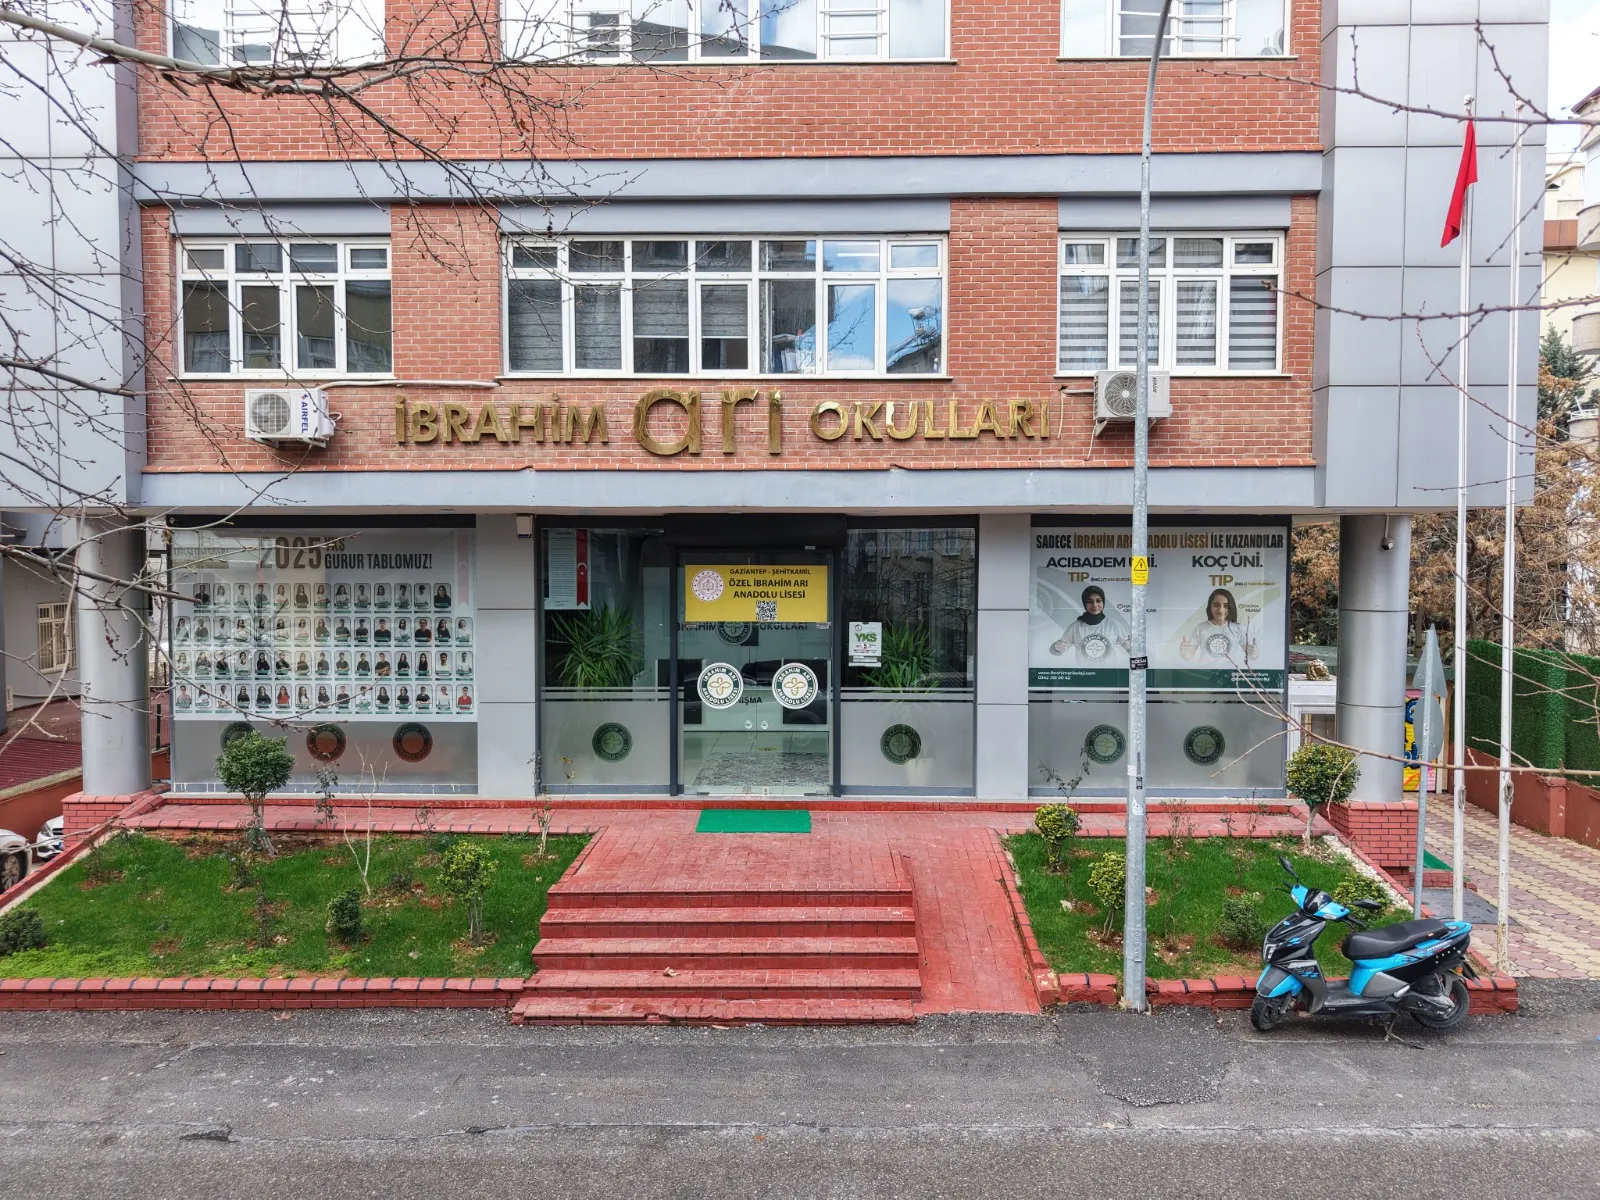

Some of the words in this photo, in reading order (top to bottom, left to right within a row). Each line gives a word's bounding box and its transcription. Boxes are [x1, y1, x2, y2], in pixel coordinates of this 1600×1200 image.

[395, 394, 609, 443] İBRAHİM
[810, 400, 1050, 441] OKULLARI
[1036, 534, 1071, 549] SADECE
[1074, 532, 1114, 549] İBRAHİM
[1180, 532, 1209, 549] LİSESİ
[1211, 532, 1224, 549] İLE
[1226, 534, 1284, 549] KAZANDILAR
[261, 536, 322, 570] 2025
[324, 553, 364, 570] GURUR
[367, 553, 433, 570] TABLOMUZ!
[1046, 556, 1126, 568] ACIBADEM
[1192, 555, 1229, 571] KOÇ
[1231, 551, 1263, 568] ÜNİ.
[771, 568, 812, 576] ŞEHİTKAMİL
[1068, 571, 1089, 583] TIP
[729, 577, 752, 587] ÖZEL
[753, 577, 792, 587] İBRAHİM
[793, 579, 808, 587] ARI
[1208, 574, 1234, 587] TIP
[733, 590, 778, 599] ANADOLU
[779, 588, 806, 599] LİSESİ
[855, 632, 877, 642] YKS
[703, 667, 727, 682] İBRAHİM
[728, 671, 738, 681] ARI
[778, 667, 800, 682] İBRAHİM
[802, 671, 812, 681] ARI
[702, 687, 725, 705] ANADOLU
[725, 687, 738, 704] LİSESİ
[777, 688, 800, 705] ANADOLU
[800, 687, 813, 704] LİSESİ
